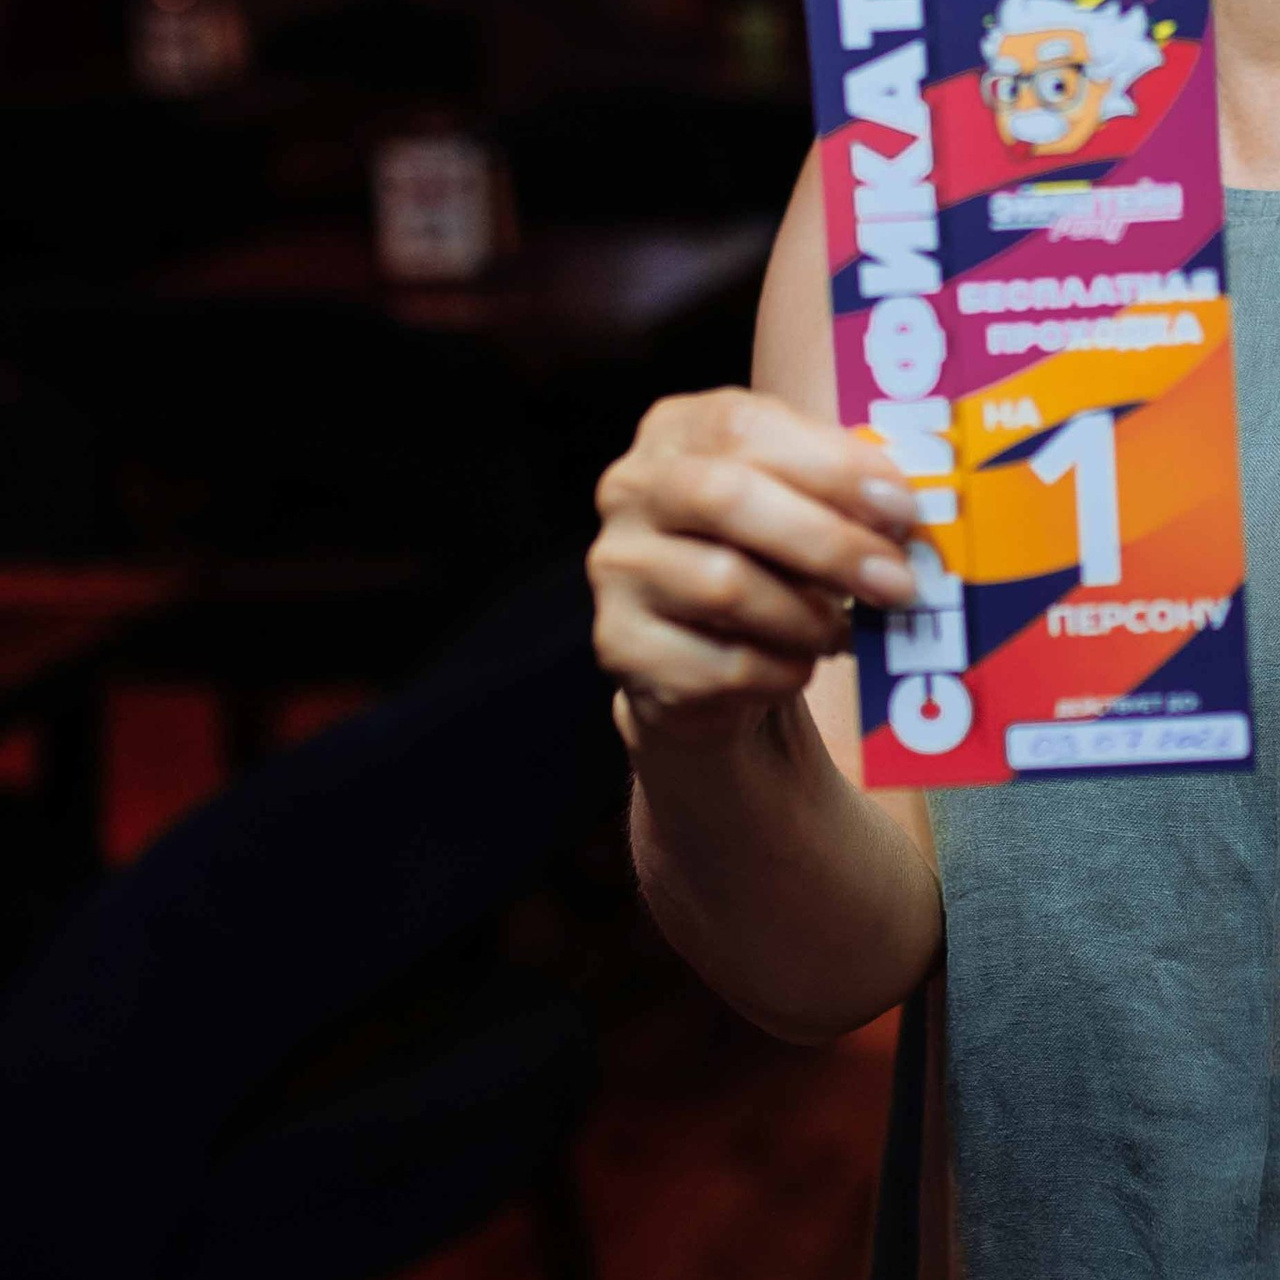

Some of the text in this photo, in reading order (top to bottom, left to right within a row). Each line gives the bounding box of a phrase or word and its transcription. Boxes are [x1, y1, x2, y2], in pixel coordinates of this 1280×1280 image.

[957, 268, 1220, 314] БЕСПЛАТНАЯ
[986, 312, 1204, 354] ПРОХОДКА
[982, 397, 1041, 431] НА
[1029, 408, 1122, 587] 1
[1046, 596, 1232, 637] ПЕРСОНУ
